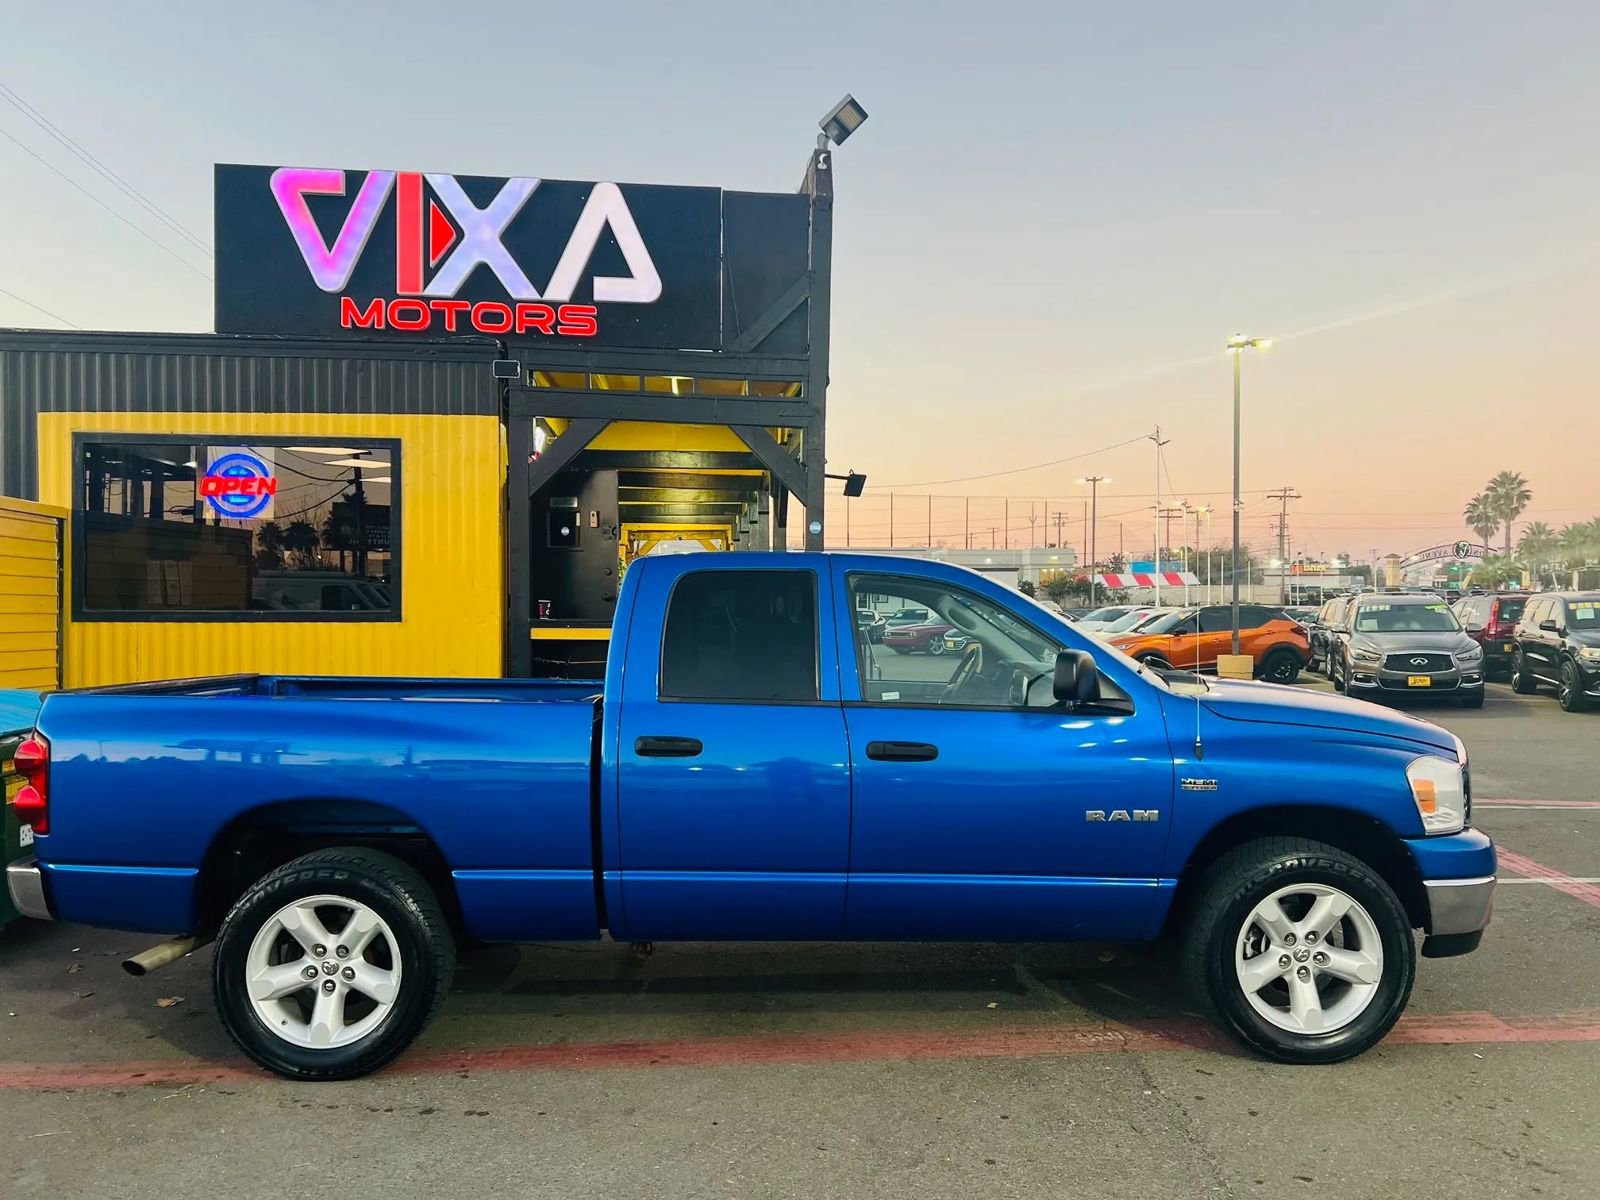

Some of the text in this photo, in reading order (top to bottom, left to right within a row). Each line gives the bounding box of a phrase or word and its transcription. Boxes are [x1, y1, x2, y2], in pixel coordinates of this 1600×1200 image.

[269, 166, 663, 304] VIXA
[339, 296, 599, 338] MOTORS
[200, 475, 277, 497] OPEN
[1085, 809, 1160, 823] RAM
